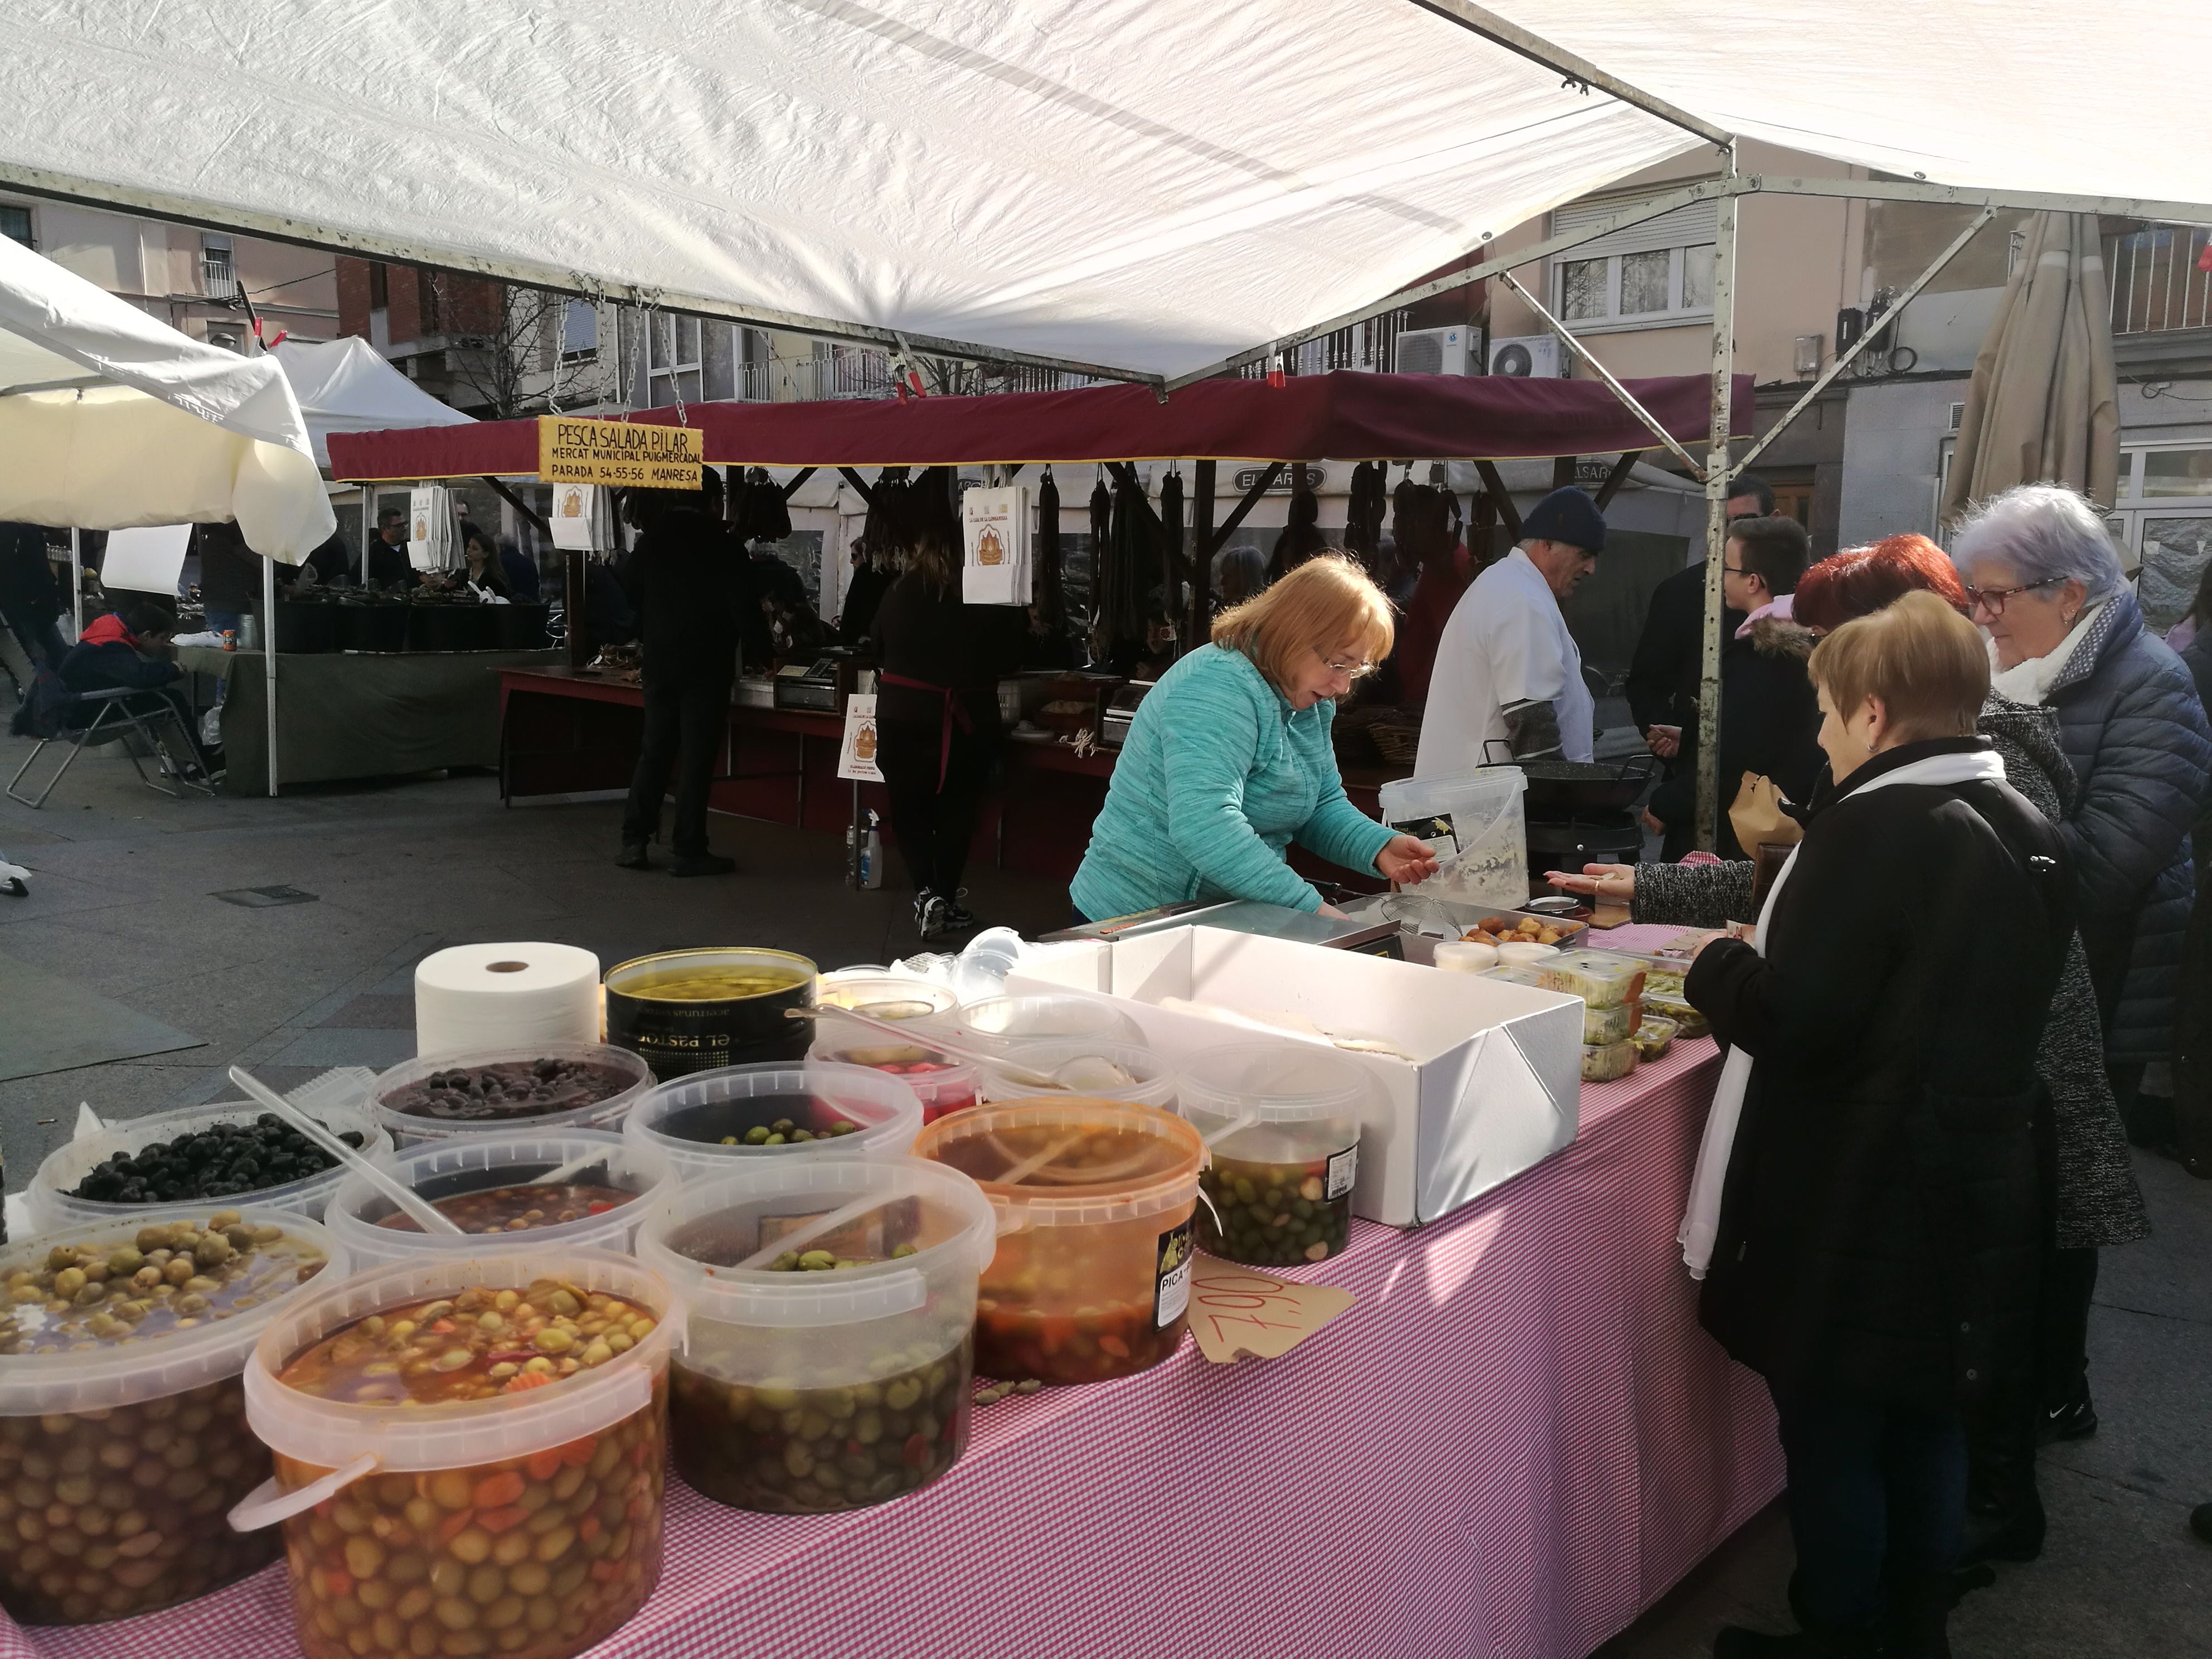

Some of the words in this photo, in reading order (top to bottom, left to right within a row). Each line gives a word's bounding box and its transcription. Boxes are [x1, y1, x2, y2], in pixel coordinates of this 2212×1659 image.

[558, 424, 598, 448] PESCA
[600, 427, 648, 450] SALADA
[652, 429, 688, 454] PILAR
[552, 448, 589, 460] MERCAT
[593, 448, 641, 462] MUNICIPAL
[643, 450, 702, 464] PUIGMERCADAL
[552, 464, 594, 478] PARADA
[600, 467, 644, 480] 54-55-56
[651, 468, 697, 482] MANRESA
